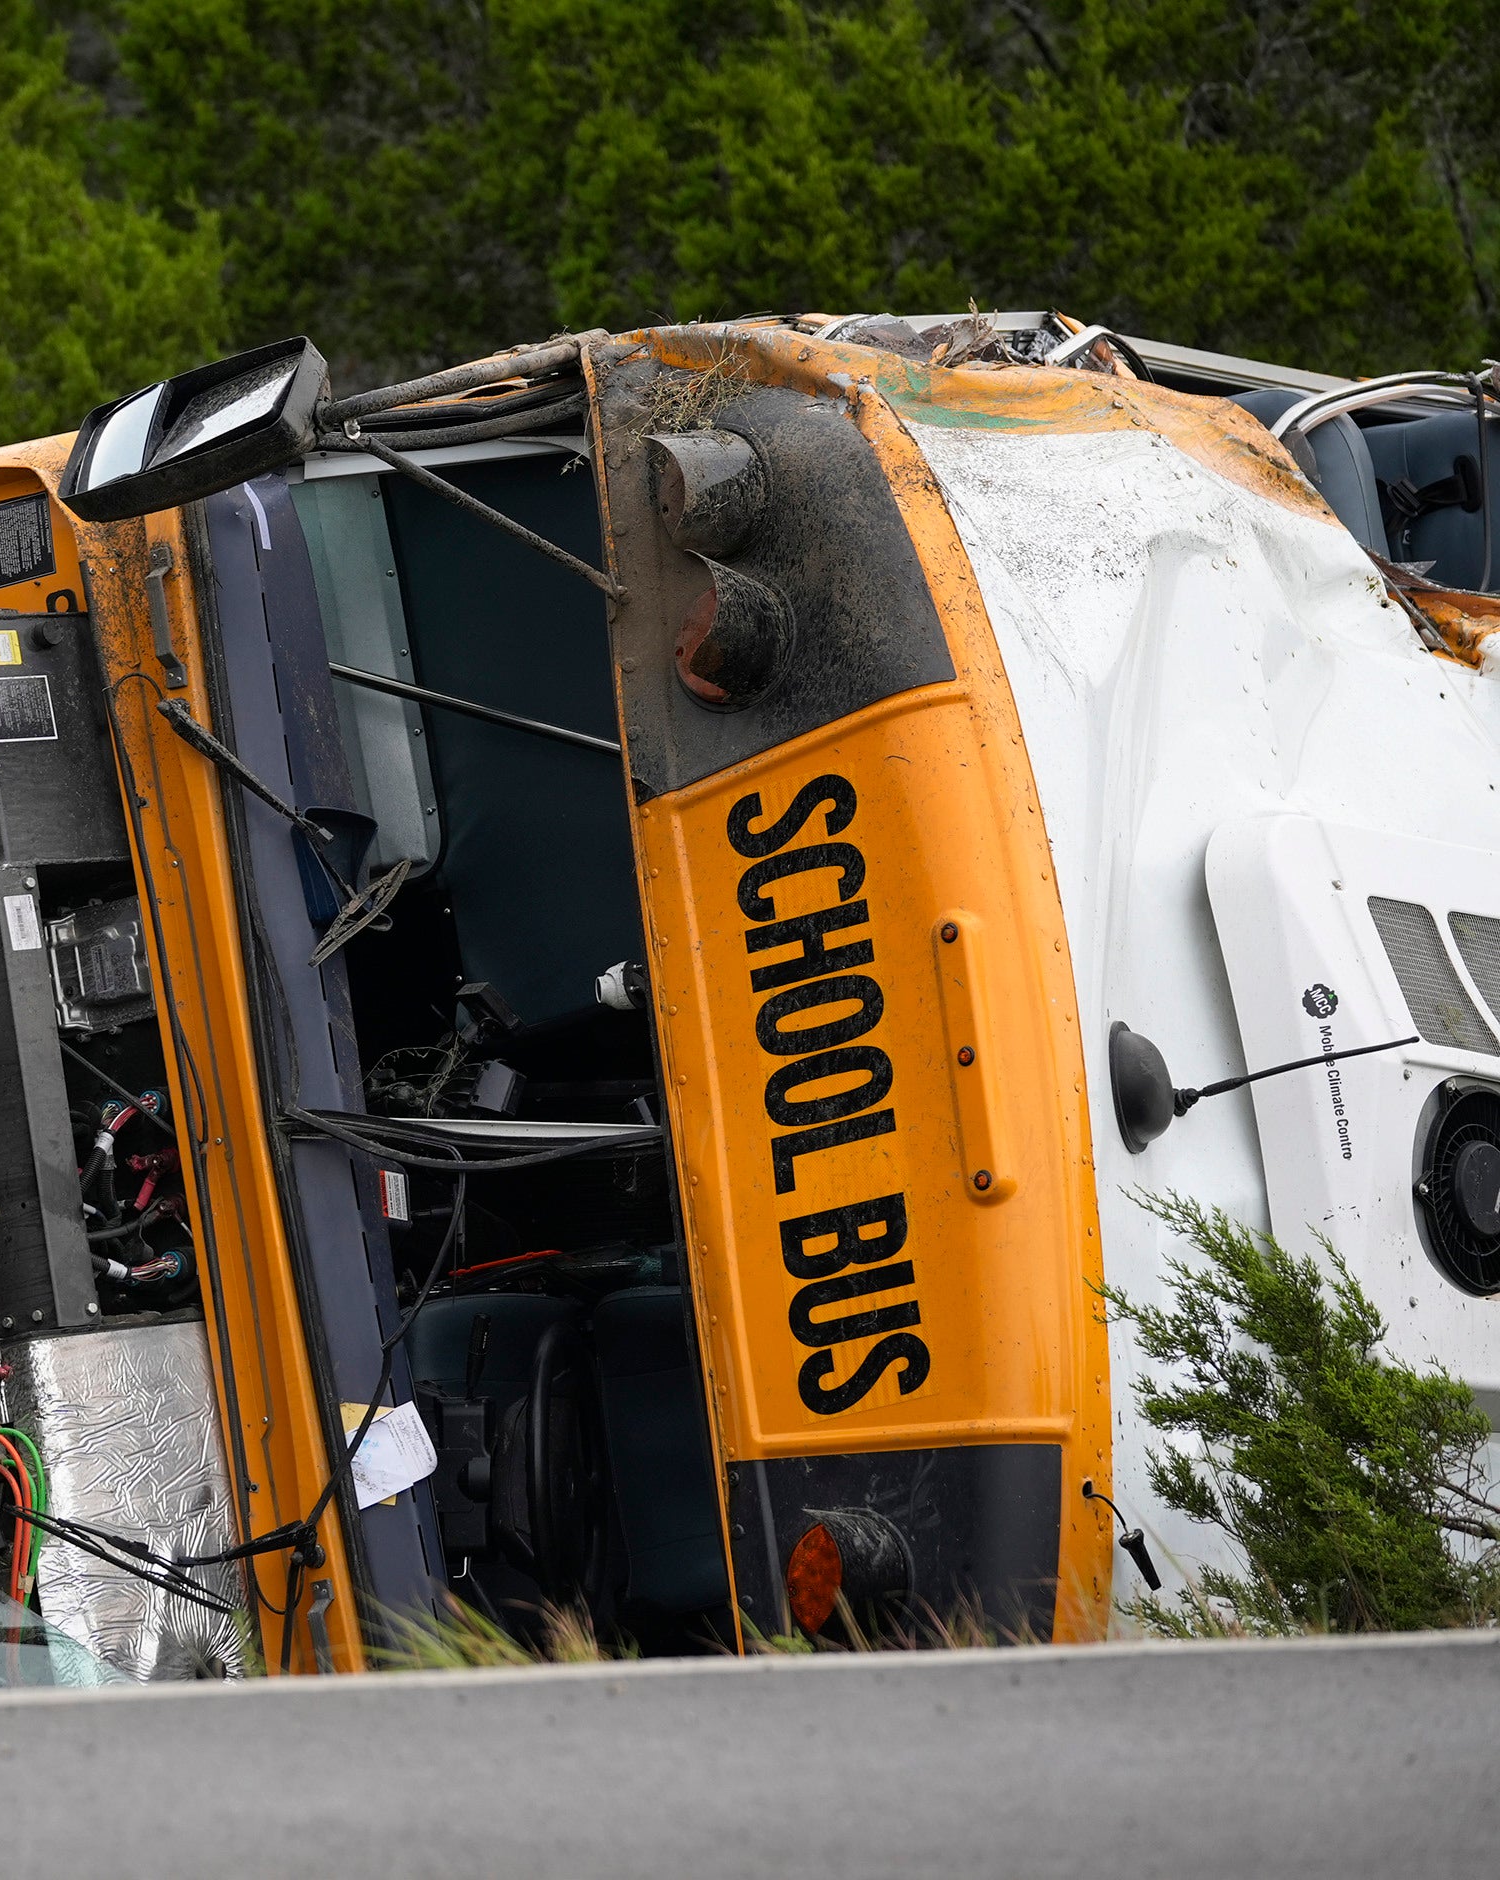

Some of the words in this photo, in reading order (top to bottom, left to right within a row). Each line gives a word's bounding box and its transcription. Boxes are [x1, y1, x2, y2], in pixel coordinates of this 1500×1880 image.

[726, 774, 897, 1195] SCHOOL
[1310, 987, 1332, 1015] MCC
[1327, 1069, 1345, 1117] Climate
[779, 1191, 931, 1415] BUS
